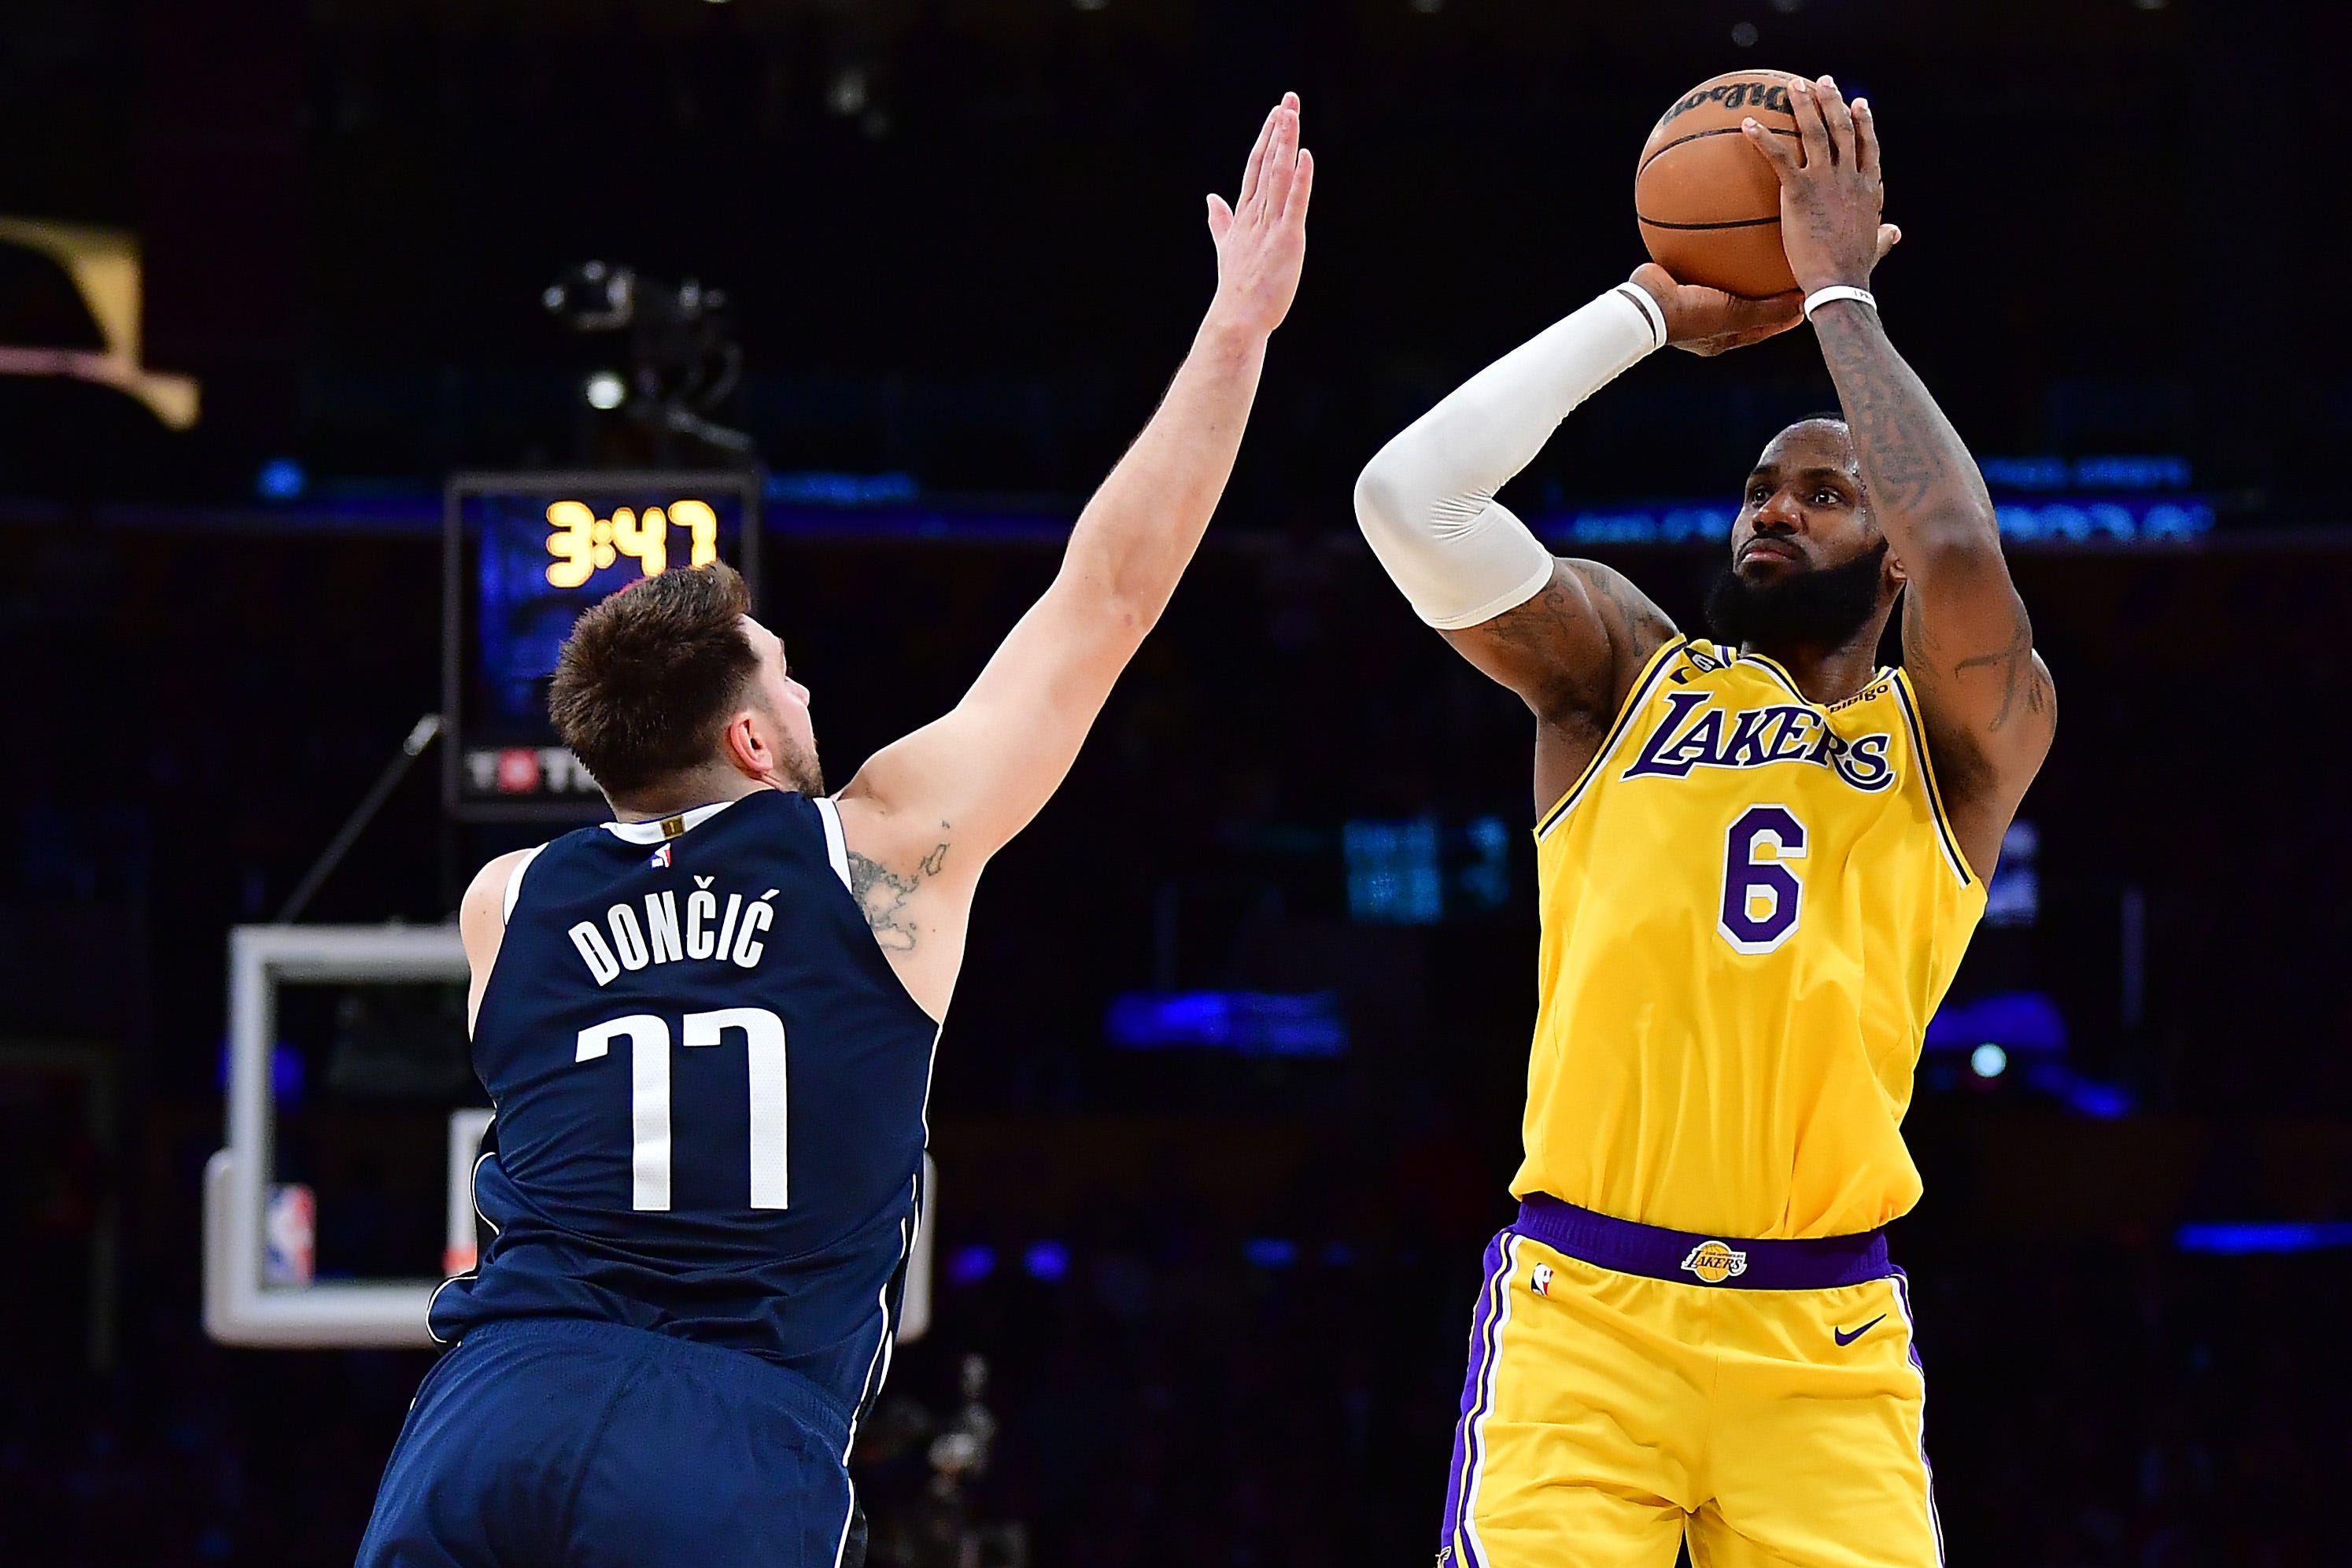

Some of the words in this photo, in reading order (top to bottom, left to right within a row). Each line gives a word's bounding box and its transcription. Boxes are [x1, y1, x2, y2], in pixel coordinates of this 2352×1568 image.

[545, 500, 718, 588] 3:47
[1619, 689, 1898, 794] LAKERS
[568, 875, 780, 987] DONČIĆ
[1717, 803, 1808, 955] 6
[574, 1007, 788, 1212] 77
[1683, 1249, 1746, 1275] LAKERS
